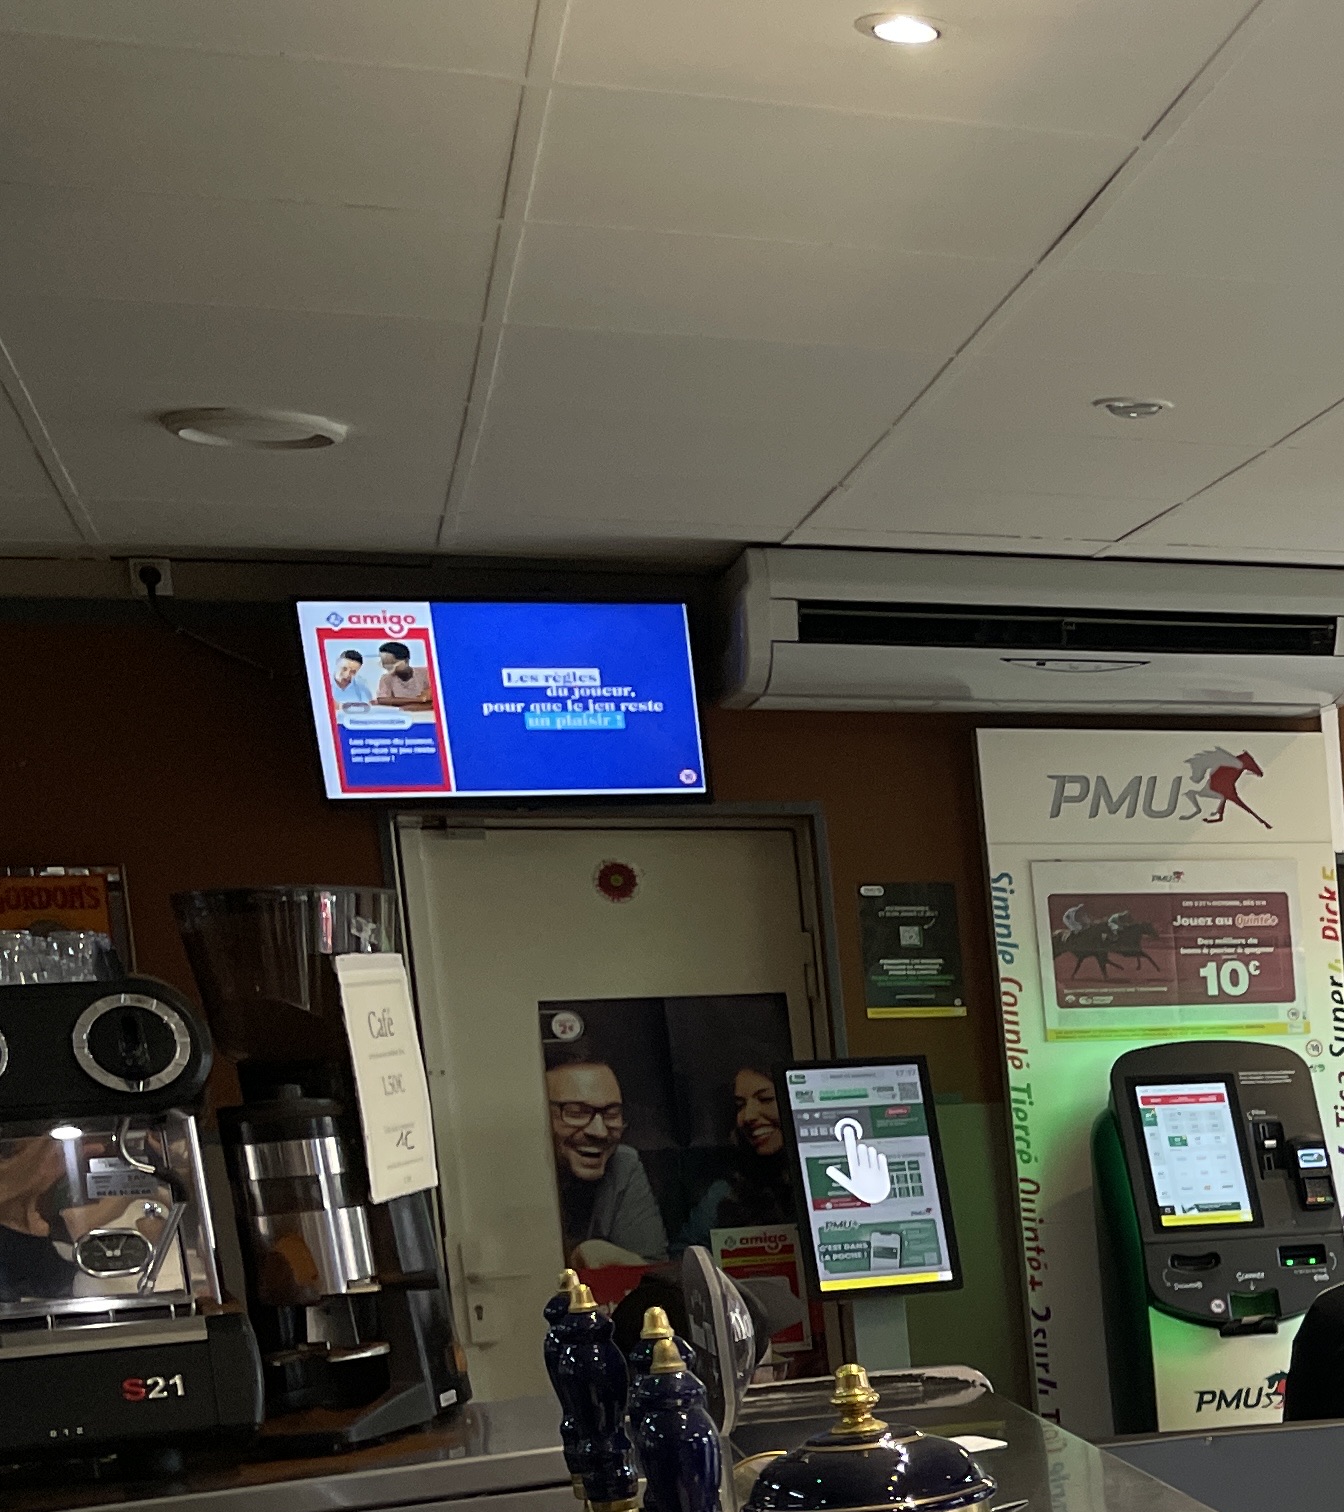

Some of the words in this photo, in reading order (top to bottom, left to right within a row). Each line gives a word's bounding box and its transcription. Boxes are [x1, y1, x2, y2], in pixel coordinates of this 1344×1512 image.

[347, 610, 416, 634] amigo
[506, 671, 538, 685] Les
[543, 670, 597, 687] règles
[482, 701, 523, 714] pour
[530, 701, 562, 715] que
[619, 700, 663, 713] reste
[527, 714, 552, 728] un
[1047, 774, 1182, 819] PMU
[0, 883, 101, 911] ORDON'S
[1173, 915, 1214, 926] Jouez
[1215, 917, 1233, 925] au
[1199, 960, 1261, 996] 10€
[368, 1008, 394, 1039] Café
[740, 1233, 788, 1254] amigo
[122, 1374, 186, 1401] S21
[1195, 1387, 1264, 1412] PMU
